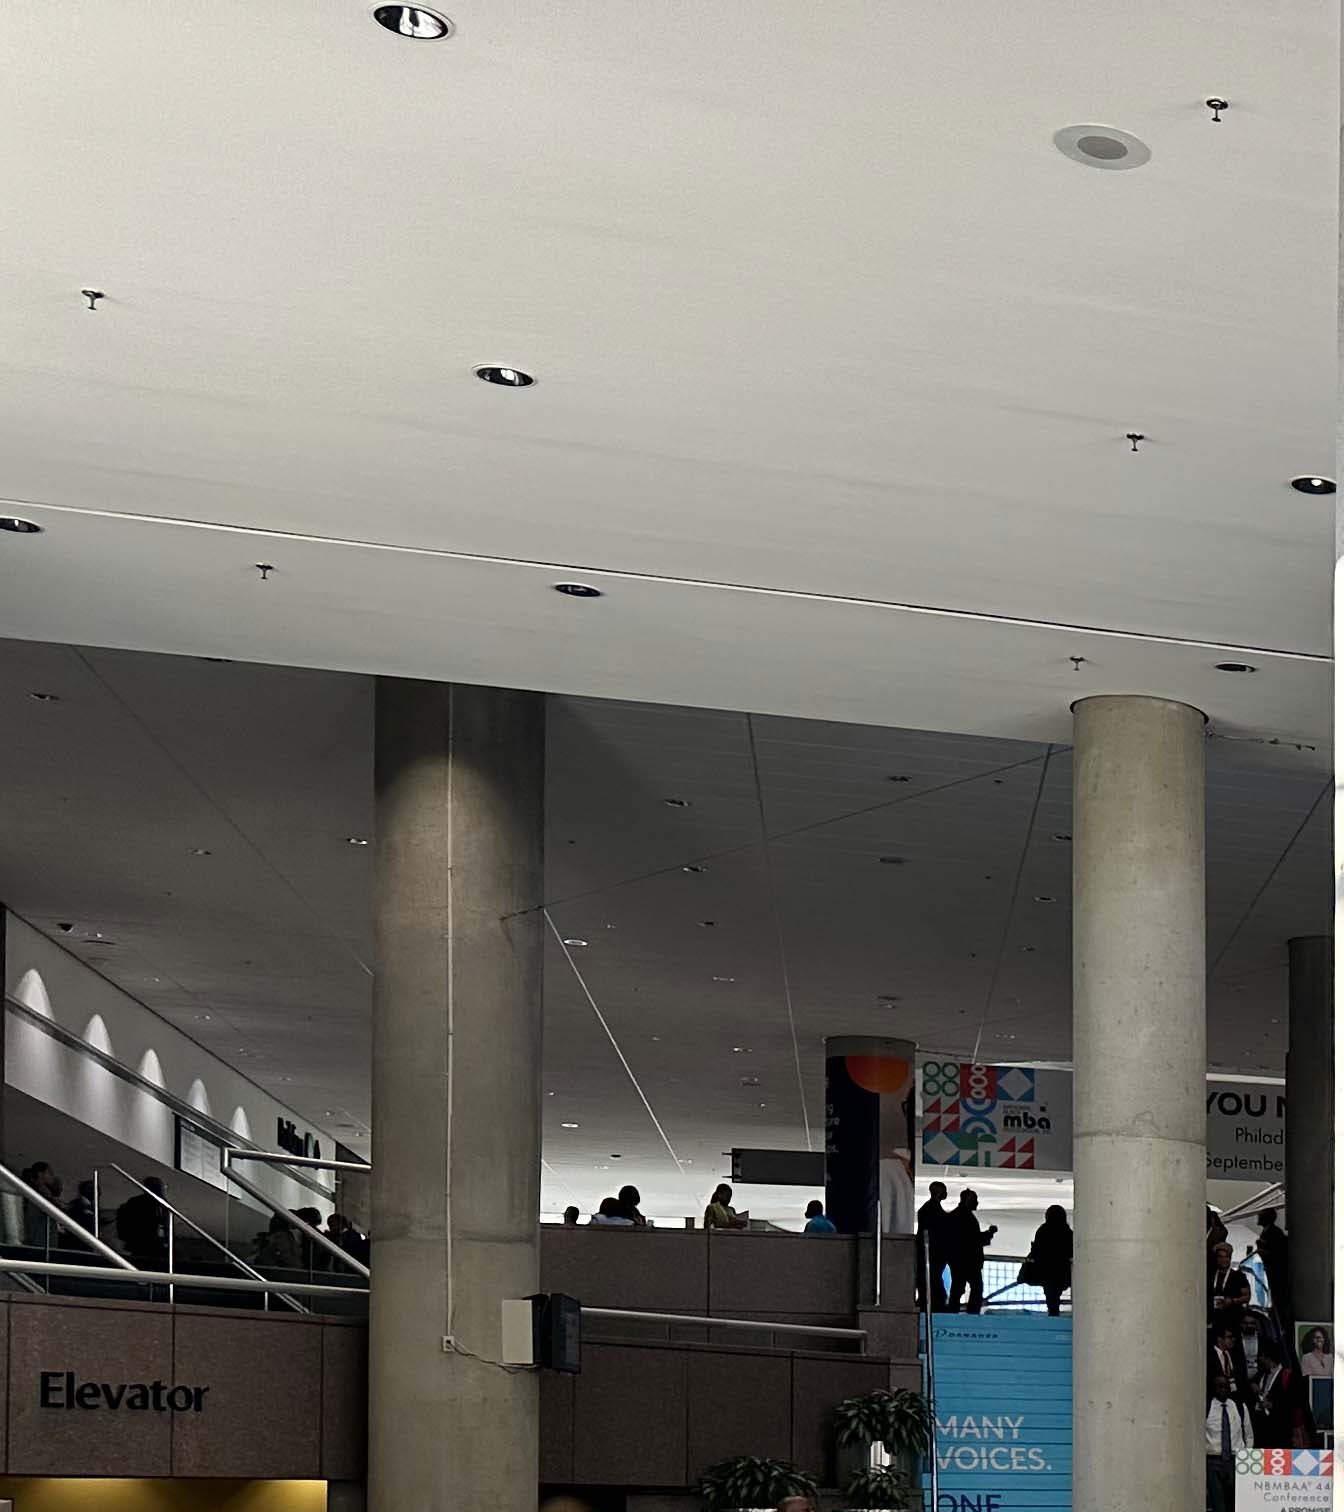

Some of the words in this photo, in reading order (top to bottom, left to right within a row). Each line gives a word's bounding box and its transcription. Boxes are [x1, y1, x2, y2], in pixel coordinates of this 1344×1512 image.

[1207, 1091, 1267, 1117] YOU
[1003, 1111, 1051, 1130] mba
[40, 1371, 210, 1412] Elevator
[935, 1415, 1024, 1439] MANY
[937, 1446, 1052, 1471] VOICES.
[1316, 1482, 1333, 1491] 44
